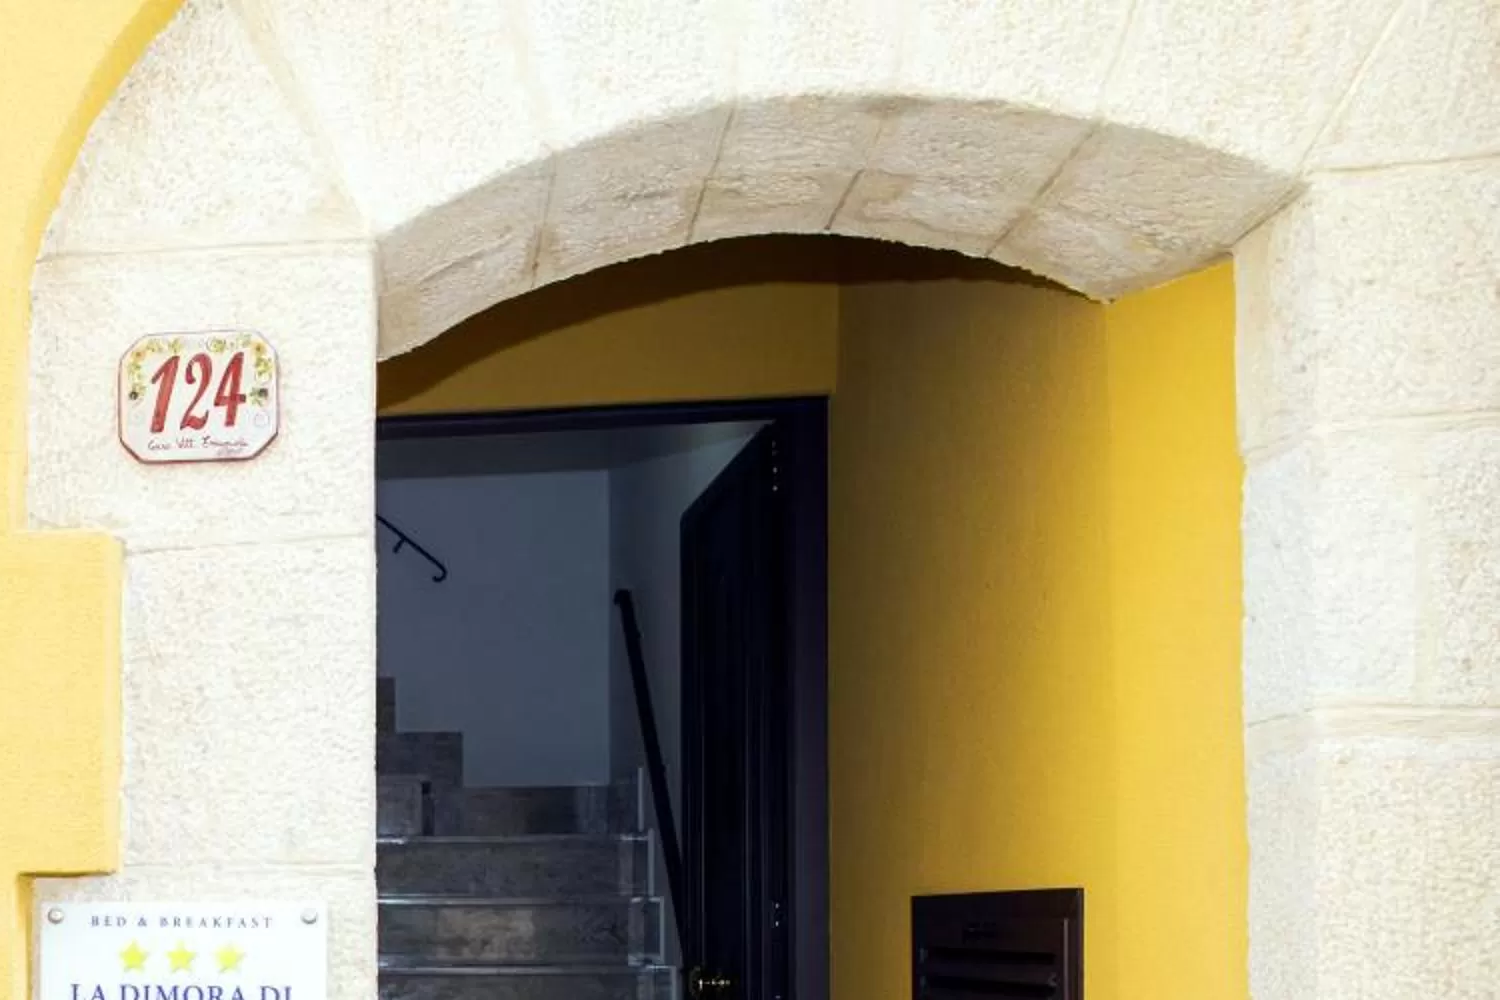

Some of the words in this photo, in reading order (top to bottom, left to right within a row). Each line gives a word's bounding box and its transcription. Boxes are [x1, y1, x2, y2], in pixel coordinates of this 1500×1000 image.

[151, 351, 246, 433] 124
[91, 915, 127, 928] BED
[137, 916, 148, 928] &
[159, 917, 274, 929] BREAKFAST
